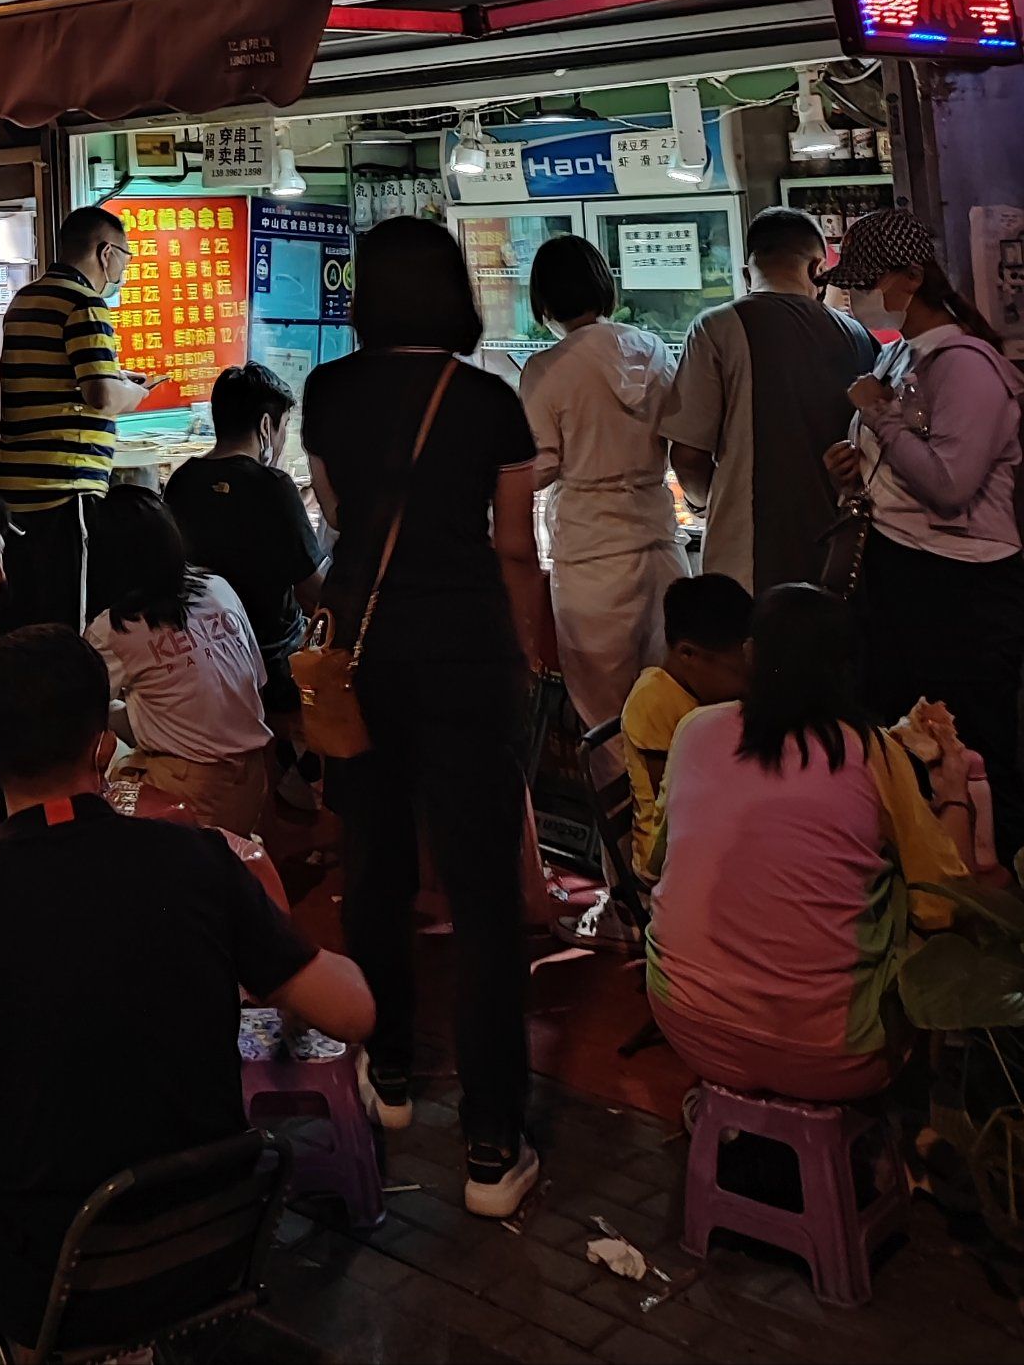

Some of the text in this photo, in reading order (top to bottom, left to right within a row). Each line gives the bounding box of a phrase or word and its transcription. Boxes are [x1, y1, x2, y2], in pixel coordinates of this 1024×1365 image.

[218, 126, 263, 145] 穿串工
[218, 146, 263, 165] 卖串工
[147, 608, 241, 665] KENZO
[166, 637, 243, 674] PARIS
